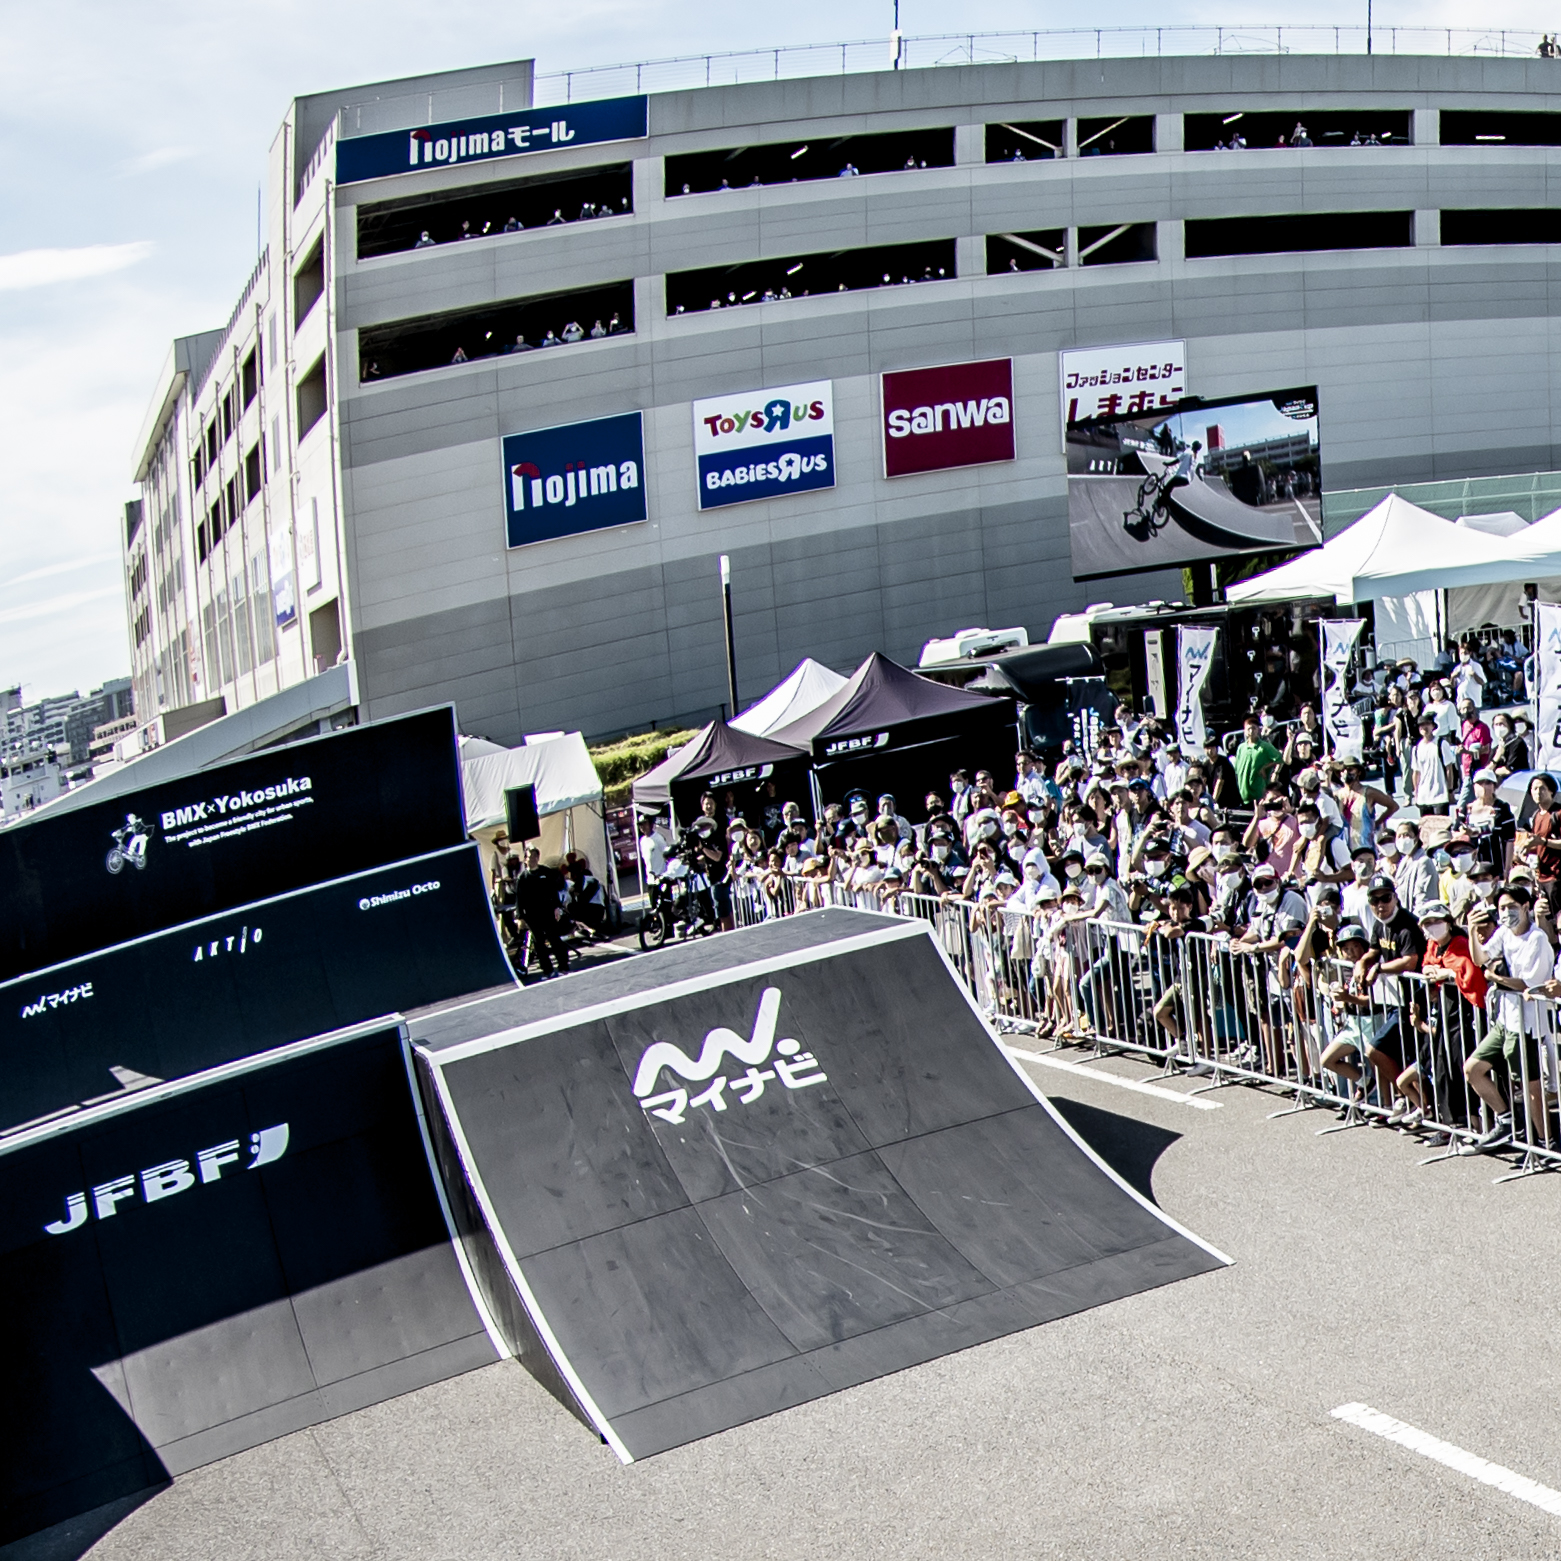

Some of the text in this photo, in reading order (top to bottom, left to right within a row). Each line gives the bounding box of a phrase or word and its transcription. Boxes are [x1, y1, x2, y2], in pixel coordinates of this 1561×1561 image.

[1066, 362, 1184, 390] ファッションセンター
[888, 396, 1010, 438] sanwa
[511, 460, 639, 512] nojima
[826, 736, 872, 753] JFBF
[709, 766, 756, 786] JFBF
[371, 881, 441, 907] Shimizu Octo
[47, 982, 95, 1009] マイナビ
[640, 1052, 828, 1125] マイナビ
[44, 1139, 240, 1235] JFBF
